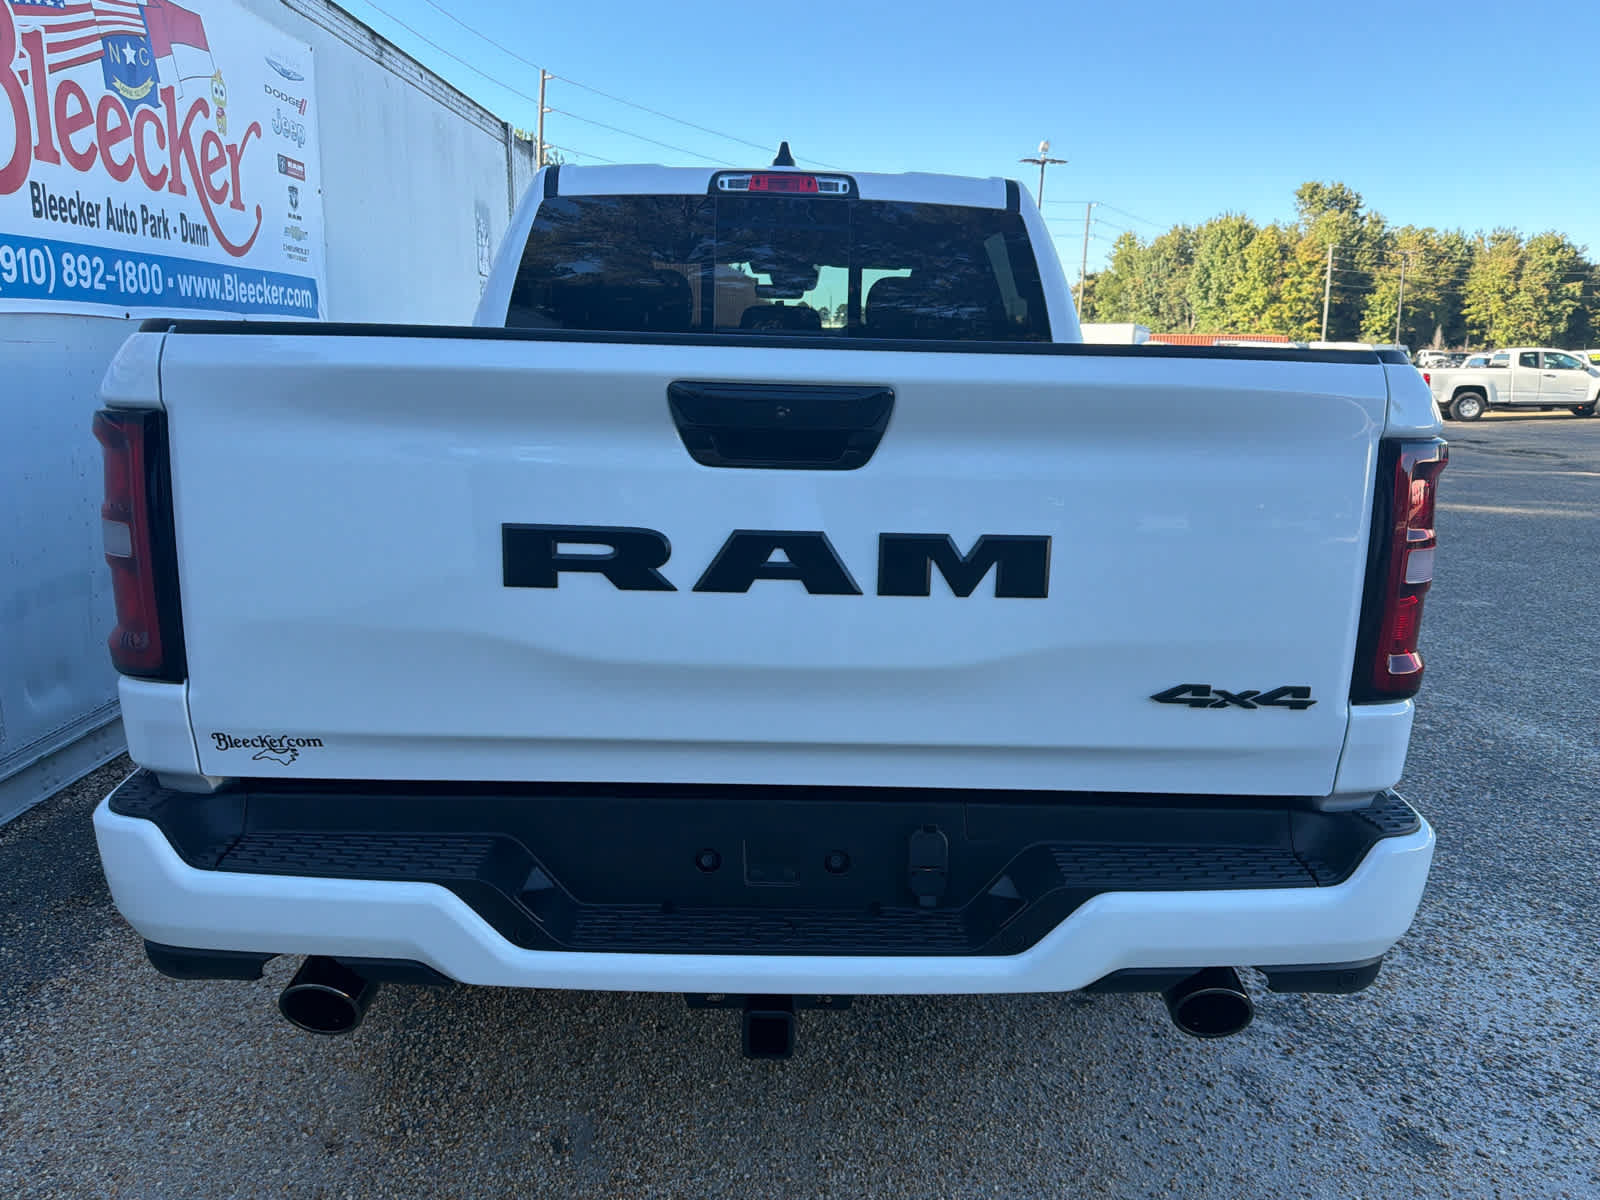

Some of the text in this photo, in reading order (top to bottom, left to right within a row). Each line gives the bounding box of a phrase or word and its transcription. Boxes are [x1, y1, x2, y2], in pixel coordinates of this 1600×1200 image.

[108, 41, 150, 66] N C
[264, 84, 302, 109] DODGE
[29, 180, 209, 247] Bleecker Auto Park Dunn
[0, 244, 313, 309] 910) 892-1800 www.Bleecker.com
[502, 522, 1053, 599] RAM
